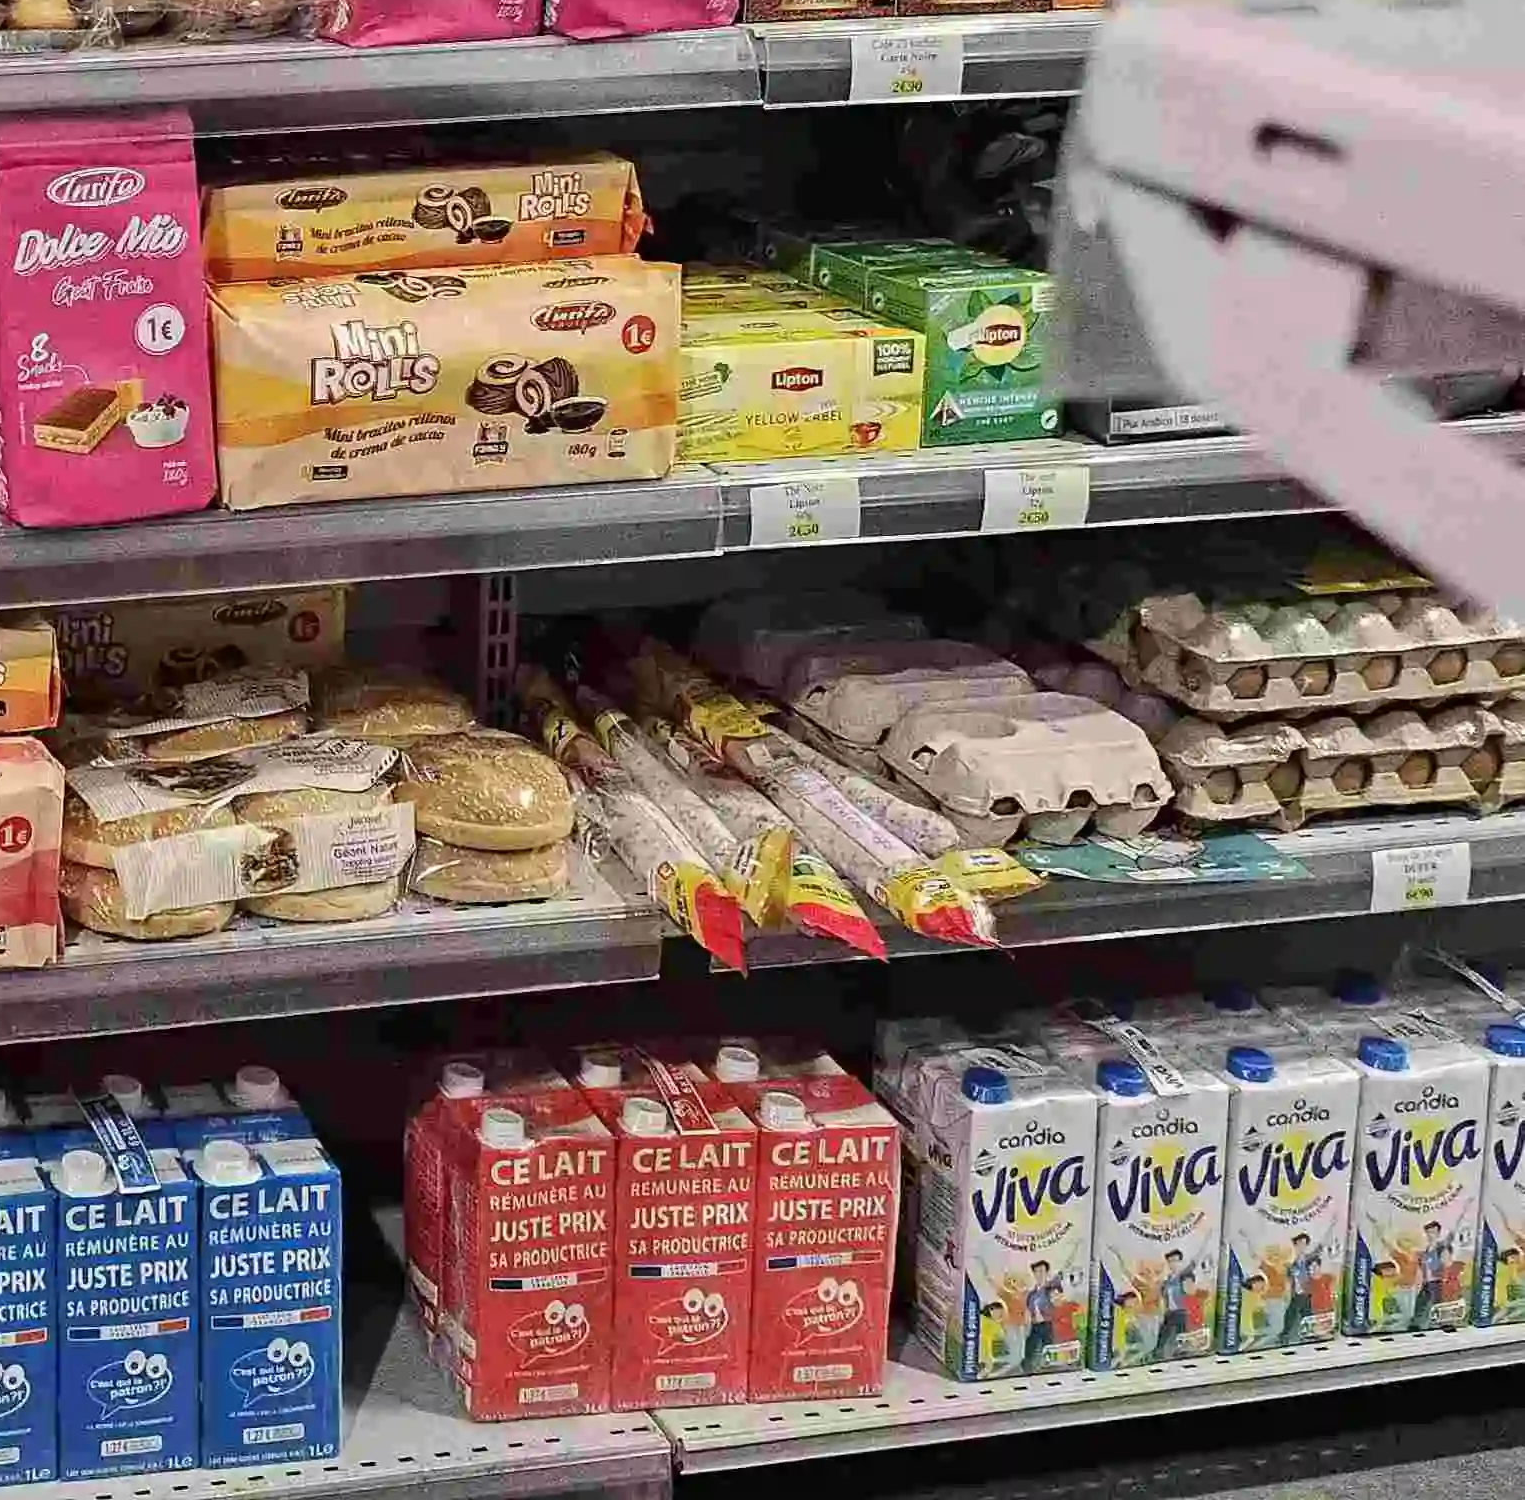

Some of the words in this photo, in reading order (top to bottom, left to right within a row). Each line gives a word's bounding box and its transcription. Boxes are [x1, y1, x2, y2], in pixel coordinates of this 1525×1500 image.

[329, 318, 421, 360] Mini
[627, 322, 652, 347] 1€
[977, 326, 1019, 346] Lipton
[876, 342, 913, 358] 100%
[310, 353, 443, 406] ROLLS
[775, 371, 820, 391] Lipton
[744, 410, 799, 427] YELLOW
[323, 426, 353, 444] Mini
[330, 443, 347, 459] de
[350, 440, 388, 458] crema
[390, 435, 406, 452] de
[999, 1129, 1067, 1150] candia
[1131, 1117, 1199, 1141] candia
[1238, 1128, 1352, 1208] Viva
[1365, 1118, 1481, 1194] Viva
[489, 1156, 531, 1189] CE
[538, 1149, 609, 1183] LAIT
[582, 1182, 608, 1202] AU
[971, 1154, 1092, 1234] Viva
[1107, 1144, 1223, 1224] Viva
[489, 1214, 554, 1244] JUSTE
[559, 1208, 608, 1236] PRIX
[22, 1240, 48, 1260] AU
[489, 1250, 508, 1269] SA
[512, 1241, 608, 1268] PRODUCTRICE
